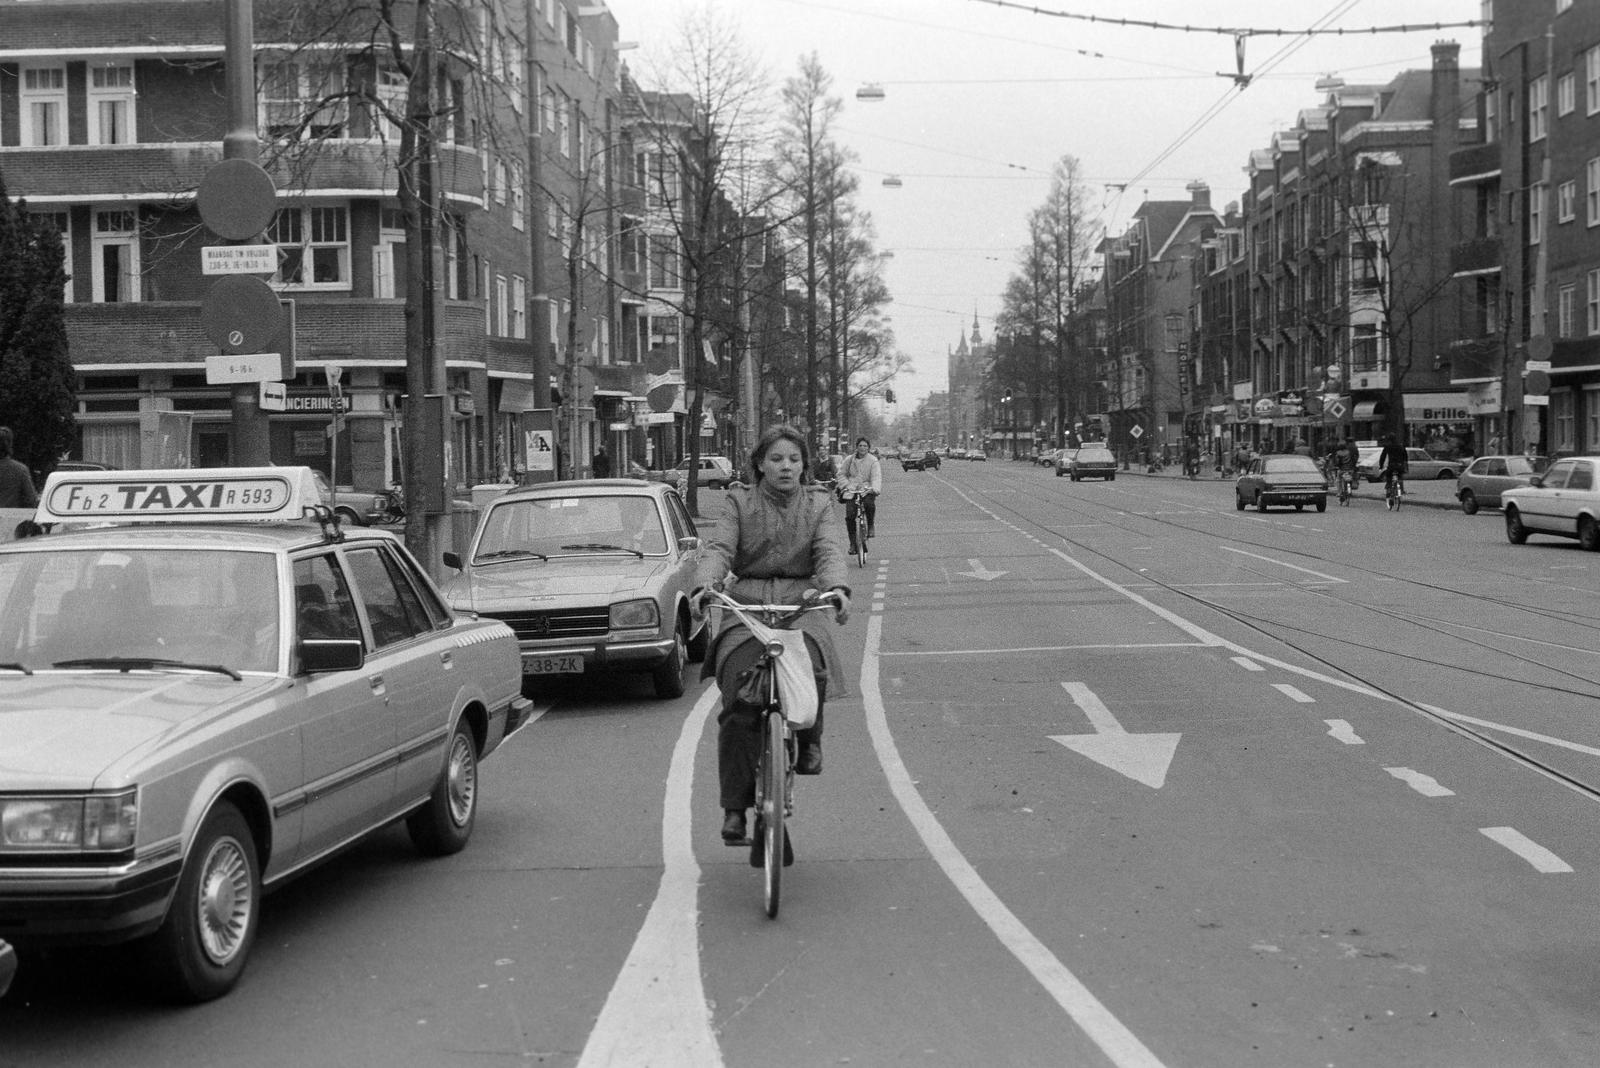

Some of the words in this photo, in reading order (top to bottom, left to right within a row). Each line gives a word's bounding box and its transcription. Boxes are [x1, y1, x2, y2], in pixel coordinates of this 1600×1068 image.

[118, 484, 224, 510] TAXI
[226, 488, 235, 505] R
[242, 488, 273, 504] 593
